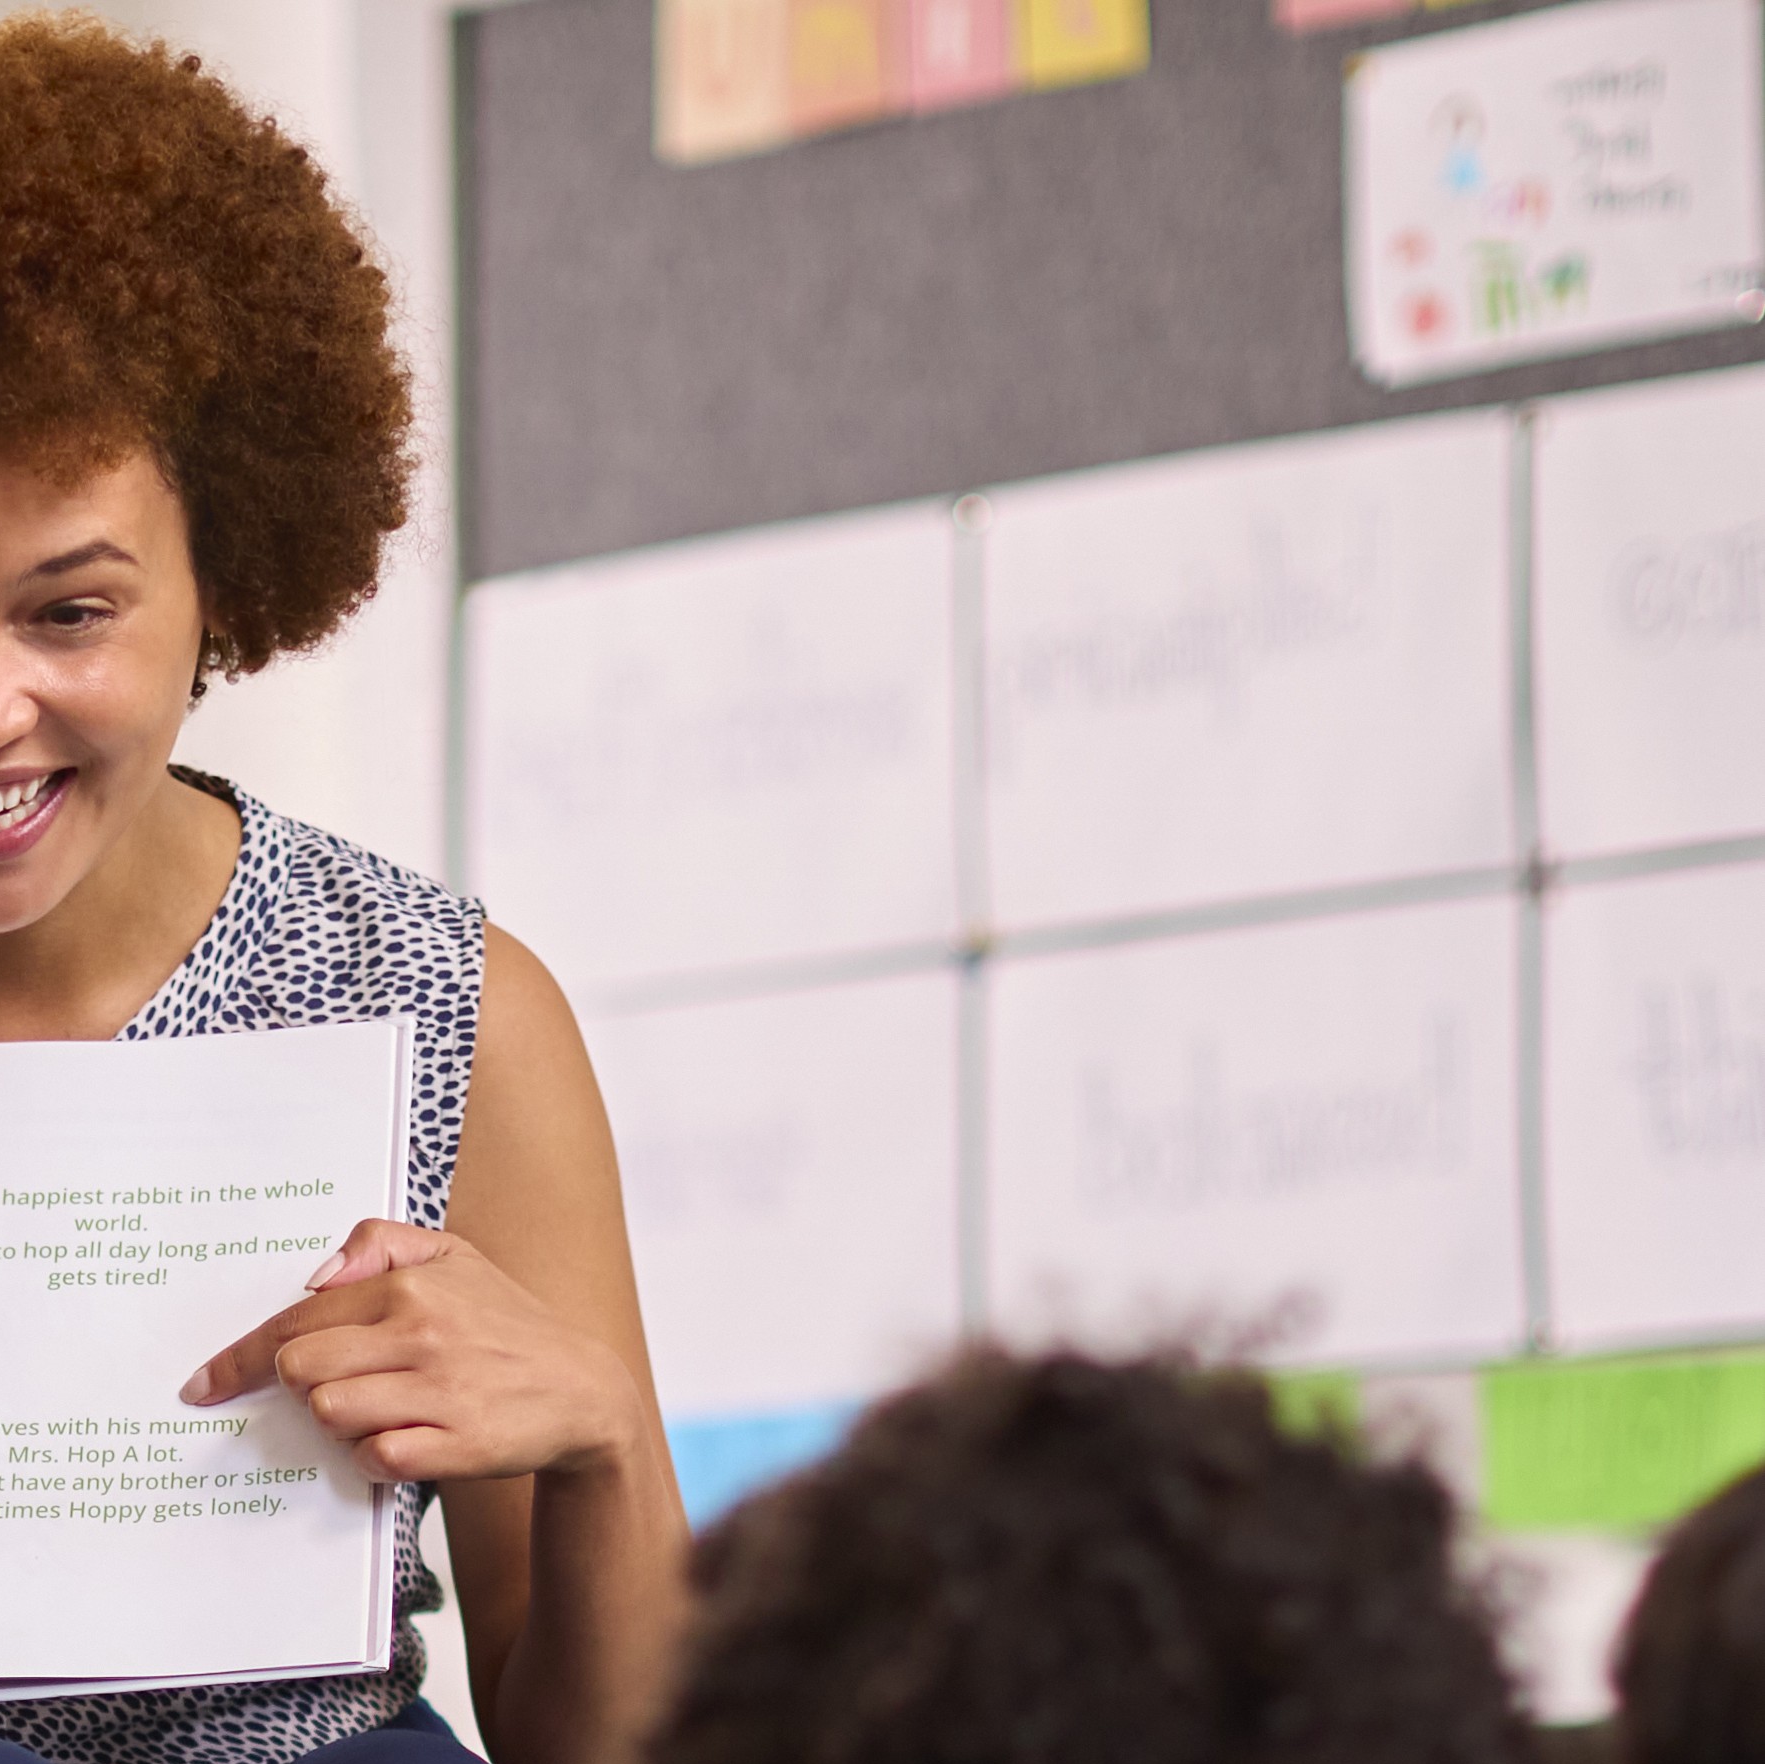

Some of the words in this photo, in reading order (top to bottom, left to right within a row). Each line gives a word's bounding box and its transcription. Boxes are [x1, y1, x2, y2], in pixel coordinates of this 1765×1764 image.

[3, 1188, 103, 1210] happiest
[113, 1187, 182, 1204] rabbit
[191, 1187, 210, 1203] in
[220, 1184, 256, 1202] the
[265, 1178, 333, 1199] whole
[75, 1214, 147, 1231] world.
[24, 1242, 67, 1263] hop
[75, 1241, 101, 1258] all
[109, 1241, 151, 1263] day
[159, 1241, 207, 1261] long
[215, 1237, 257, 1255] and
[266, 1236, 331, 1253] never
[47, 1270, 96, 1290] gets
[106, 1268, 167, 1285] tired!
[48, 1418, 98, 1435] with
[108, 1418, 140, 1435] his
[149, 1418, 248, 1437] mummy
[9, 1447, 58, 1463] Mrs.
[68, 1446, 115, 1468] Hop
[123, 1446, 138, 1462] A
[147, 1445, 182, 1462] lot.
[12, 1473, 65, 1490] have
[73, 1478, 114, 1495] any
[121, 1472, 208, 1490] brother
[215, 1472, 238, 1487] or
[244, 1468, 316, 1485] sisters
[70, 1502, 146, 1523] Hoppy
[153, 1501, 202, 1523] gets
[212, 1494, 286, 1516] lonely.
